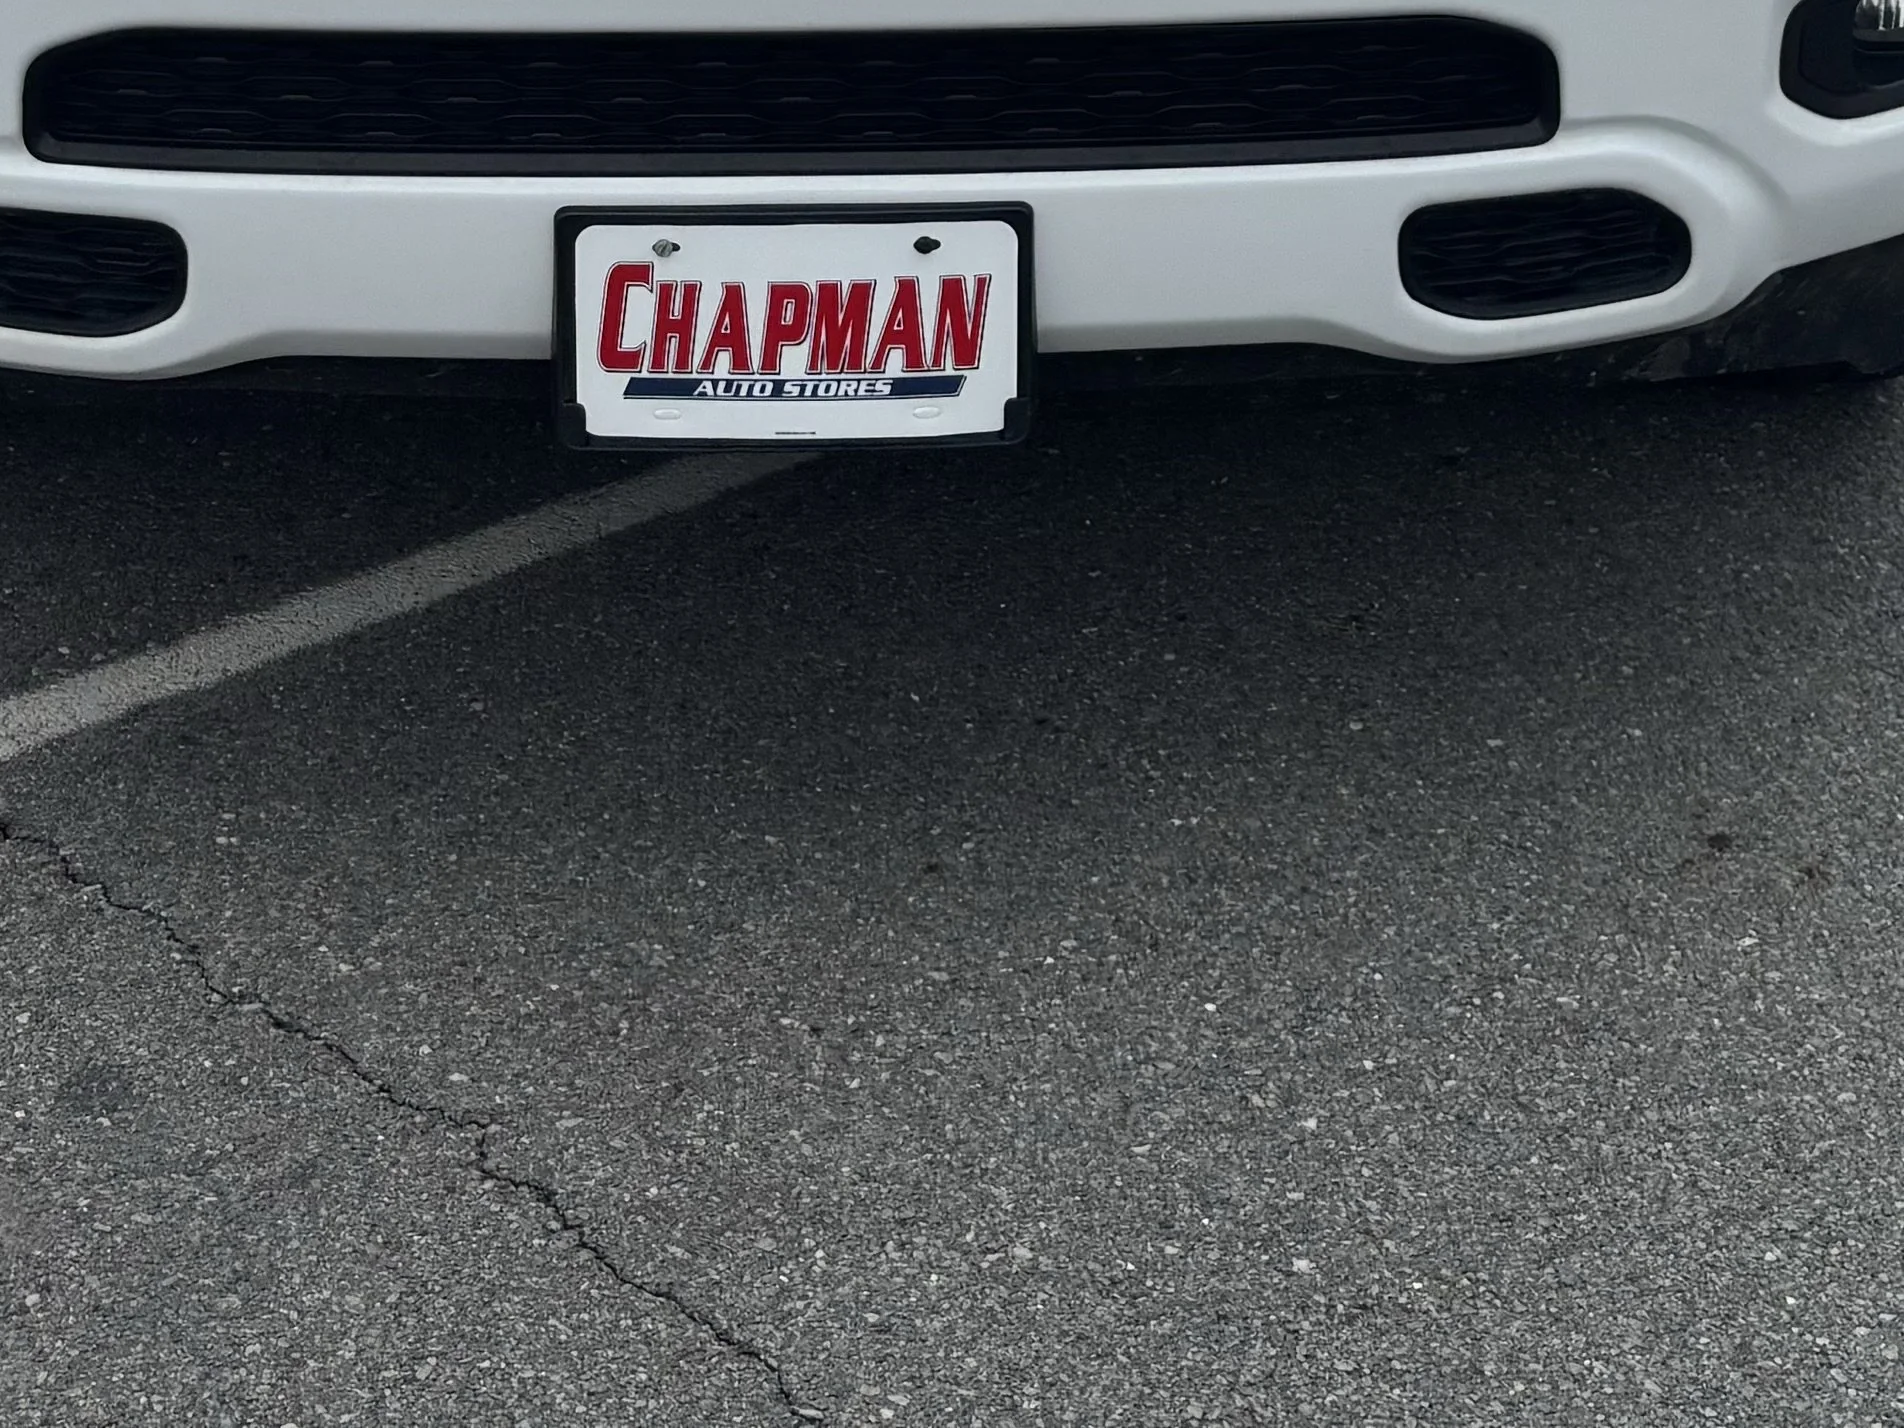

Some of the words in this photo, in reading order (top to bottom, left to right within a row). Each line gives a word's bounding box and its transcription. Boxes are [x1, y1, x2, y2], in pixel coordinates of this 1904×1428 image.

[596, 261, 992, 375] CHAPMAN
[694, 379, 774, 397] AUTO
[782, 378, 894, 397] STORES
